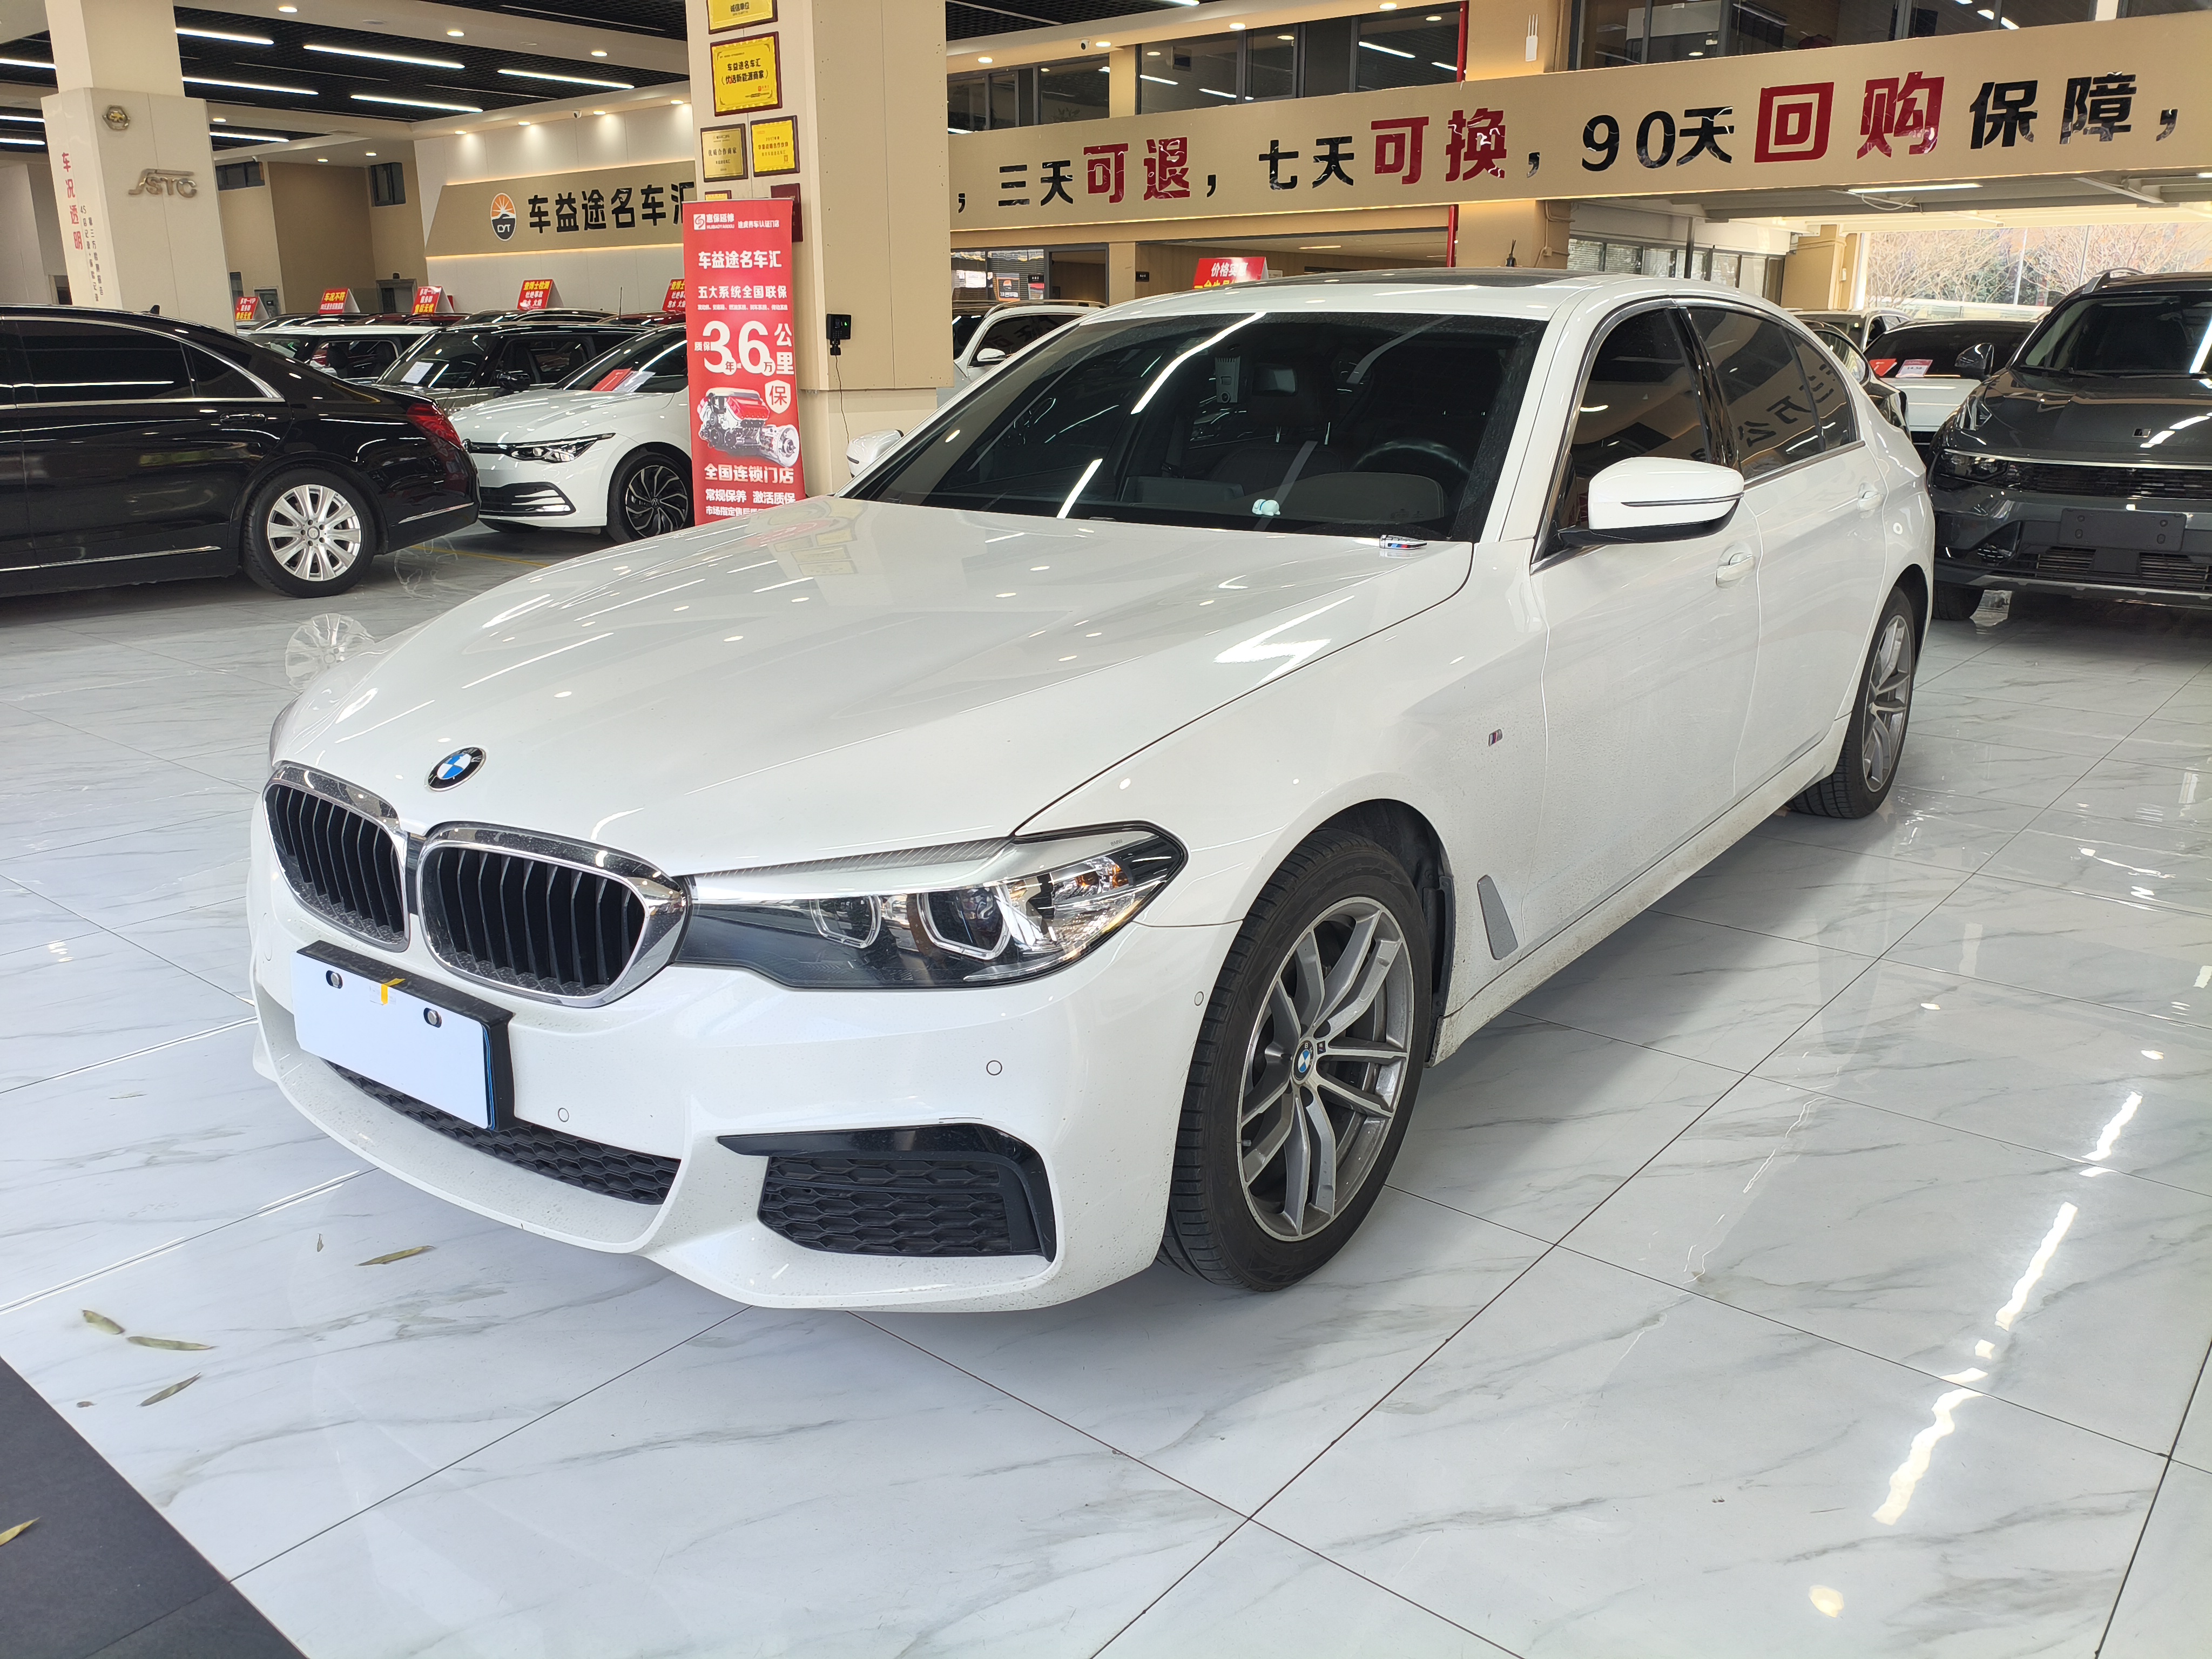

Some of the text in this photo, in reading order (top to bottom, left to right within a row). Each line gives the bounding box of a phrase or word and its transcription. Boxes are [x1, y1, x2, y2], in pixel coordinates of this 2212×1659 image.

[62, 152, 84, 250] 车况透明
[698, 250, 782, 269] 车益途名车汇
[698, 285, 787, 299] 五大系统全国联保
[704, 463, 794, 484] 全国连锁门店
[705, 488, 796, 505] 常规保养 激活质保
